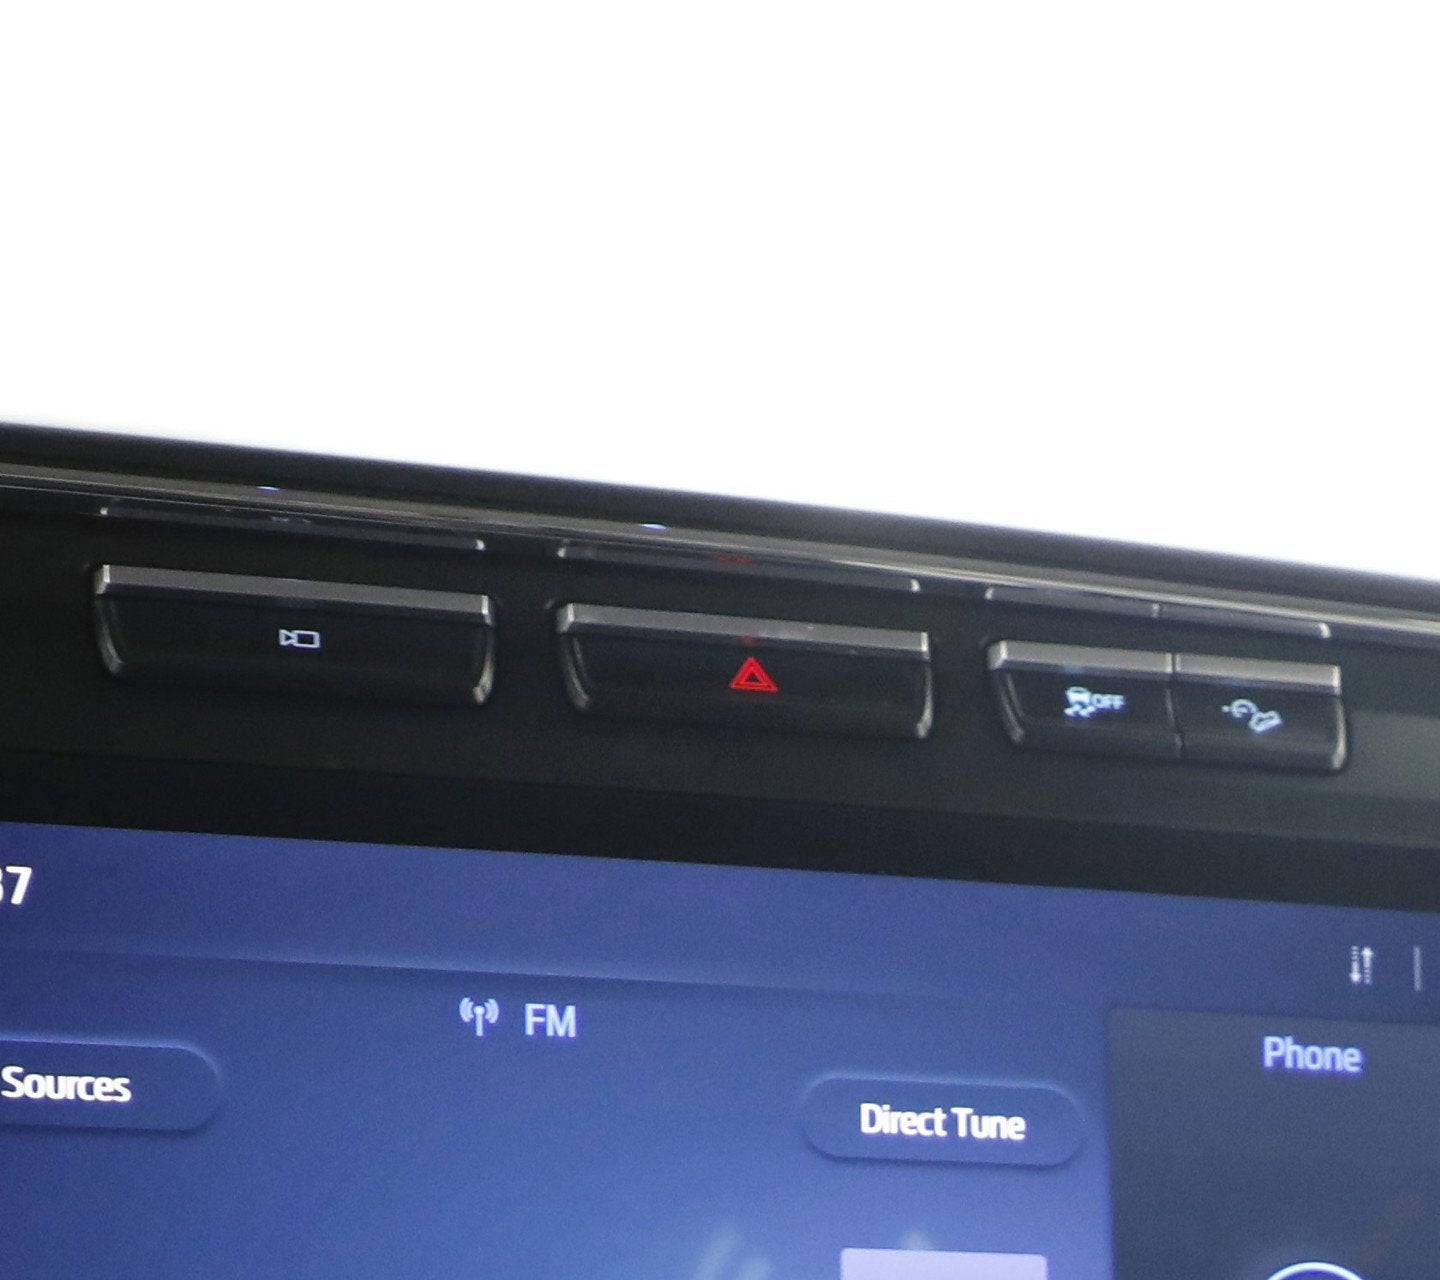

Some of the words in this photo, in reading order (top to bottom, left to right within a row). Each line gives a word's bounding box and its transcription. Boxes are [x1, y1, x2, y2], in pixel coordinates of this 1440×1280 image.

[1091, 692, 1125, 710] OFF
[524, 1002, 577, 1038] FM
[1262, 1035, 1362, 1073] Phone
[0, 1064, 132, 1103] Sources
[859, 1101, 948, 1138] Direct
[949, 1105, 1027, 1141] Tune
